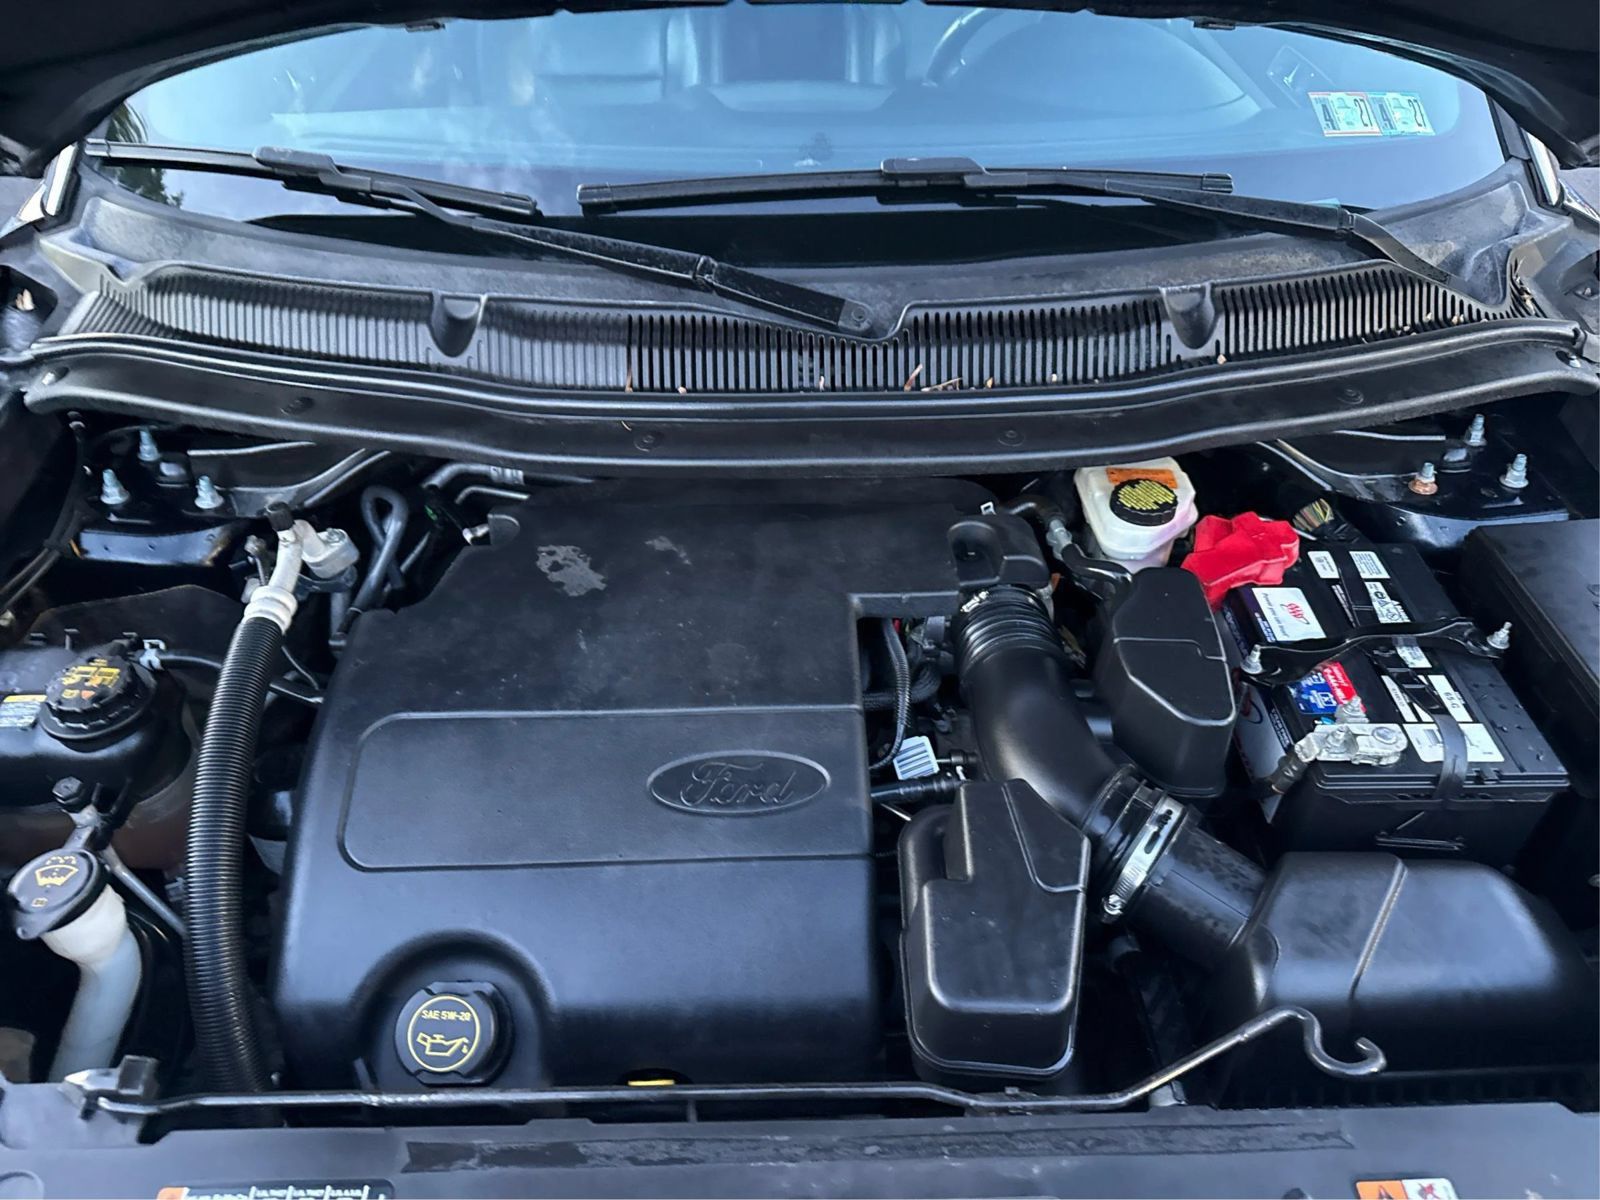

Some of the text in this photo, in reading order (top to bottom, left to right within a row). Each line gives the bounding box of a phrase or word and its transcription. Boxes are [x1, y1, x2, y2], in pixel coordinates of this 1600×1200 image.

[1353, 98, 1373, 127] 27
[1407, 98, 1427, 127] 27
[680, 761, 798, 807] Ford
[421, 1009, 472, 1022] SAE 5W-20
